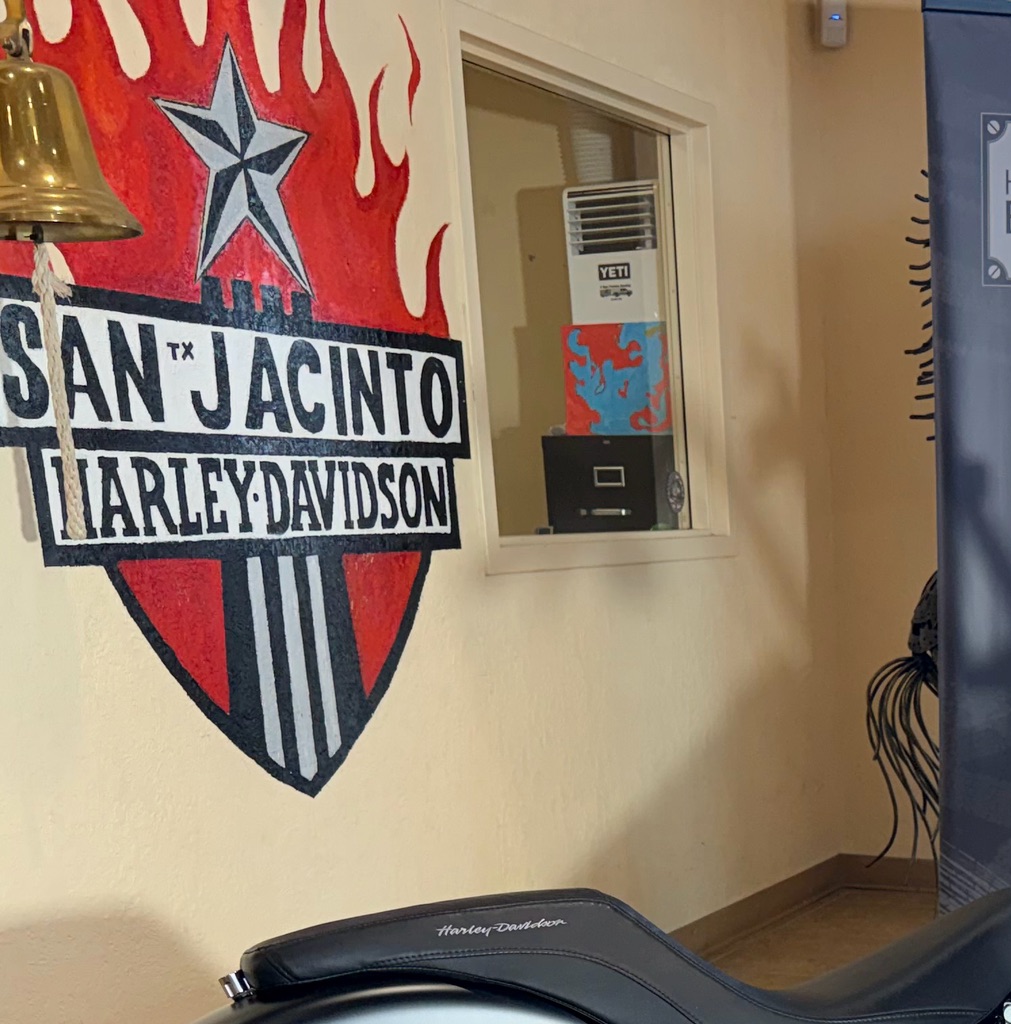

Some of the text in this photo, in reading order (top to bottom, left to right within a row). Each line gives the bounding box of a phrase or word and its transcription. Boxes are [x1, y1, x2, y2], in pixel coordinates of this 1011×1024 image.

[600, 265, 629, 279] YETI
[0, 303, 453, 439] SAN TX JACINTO
[436, 918, 567, 937] Harley-Davidson
